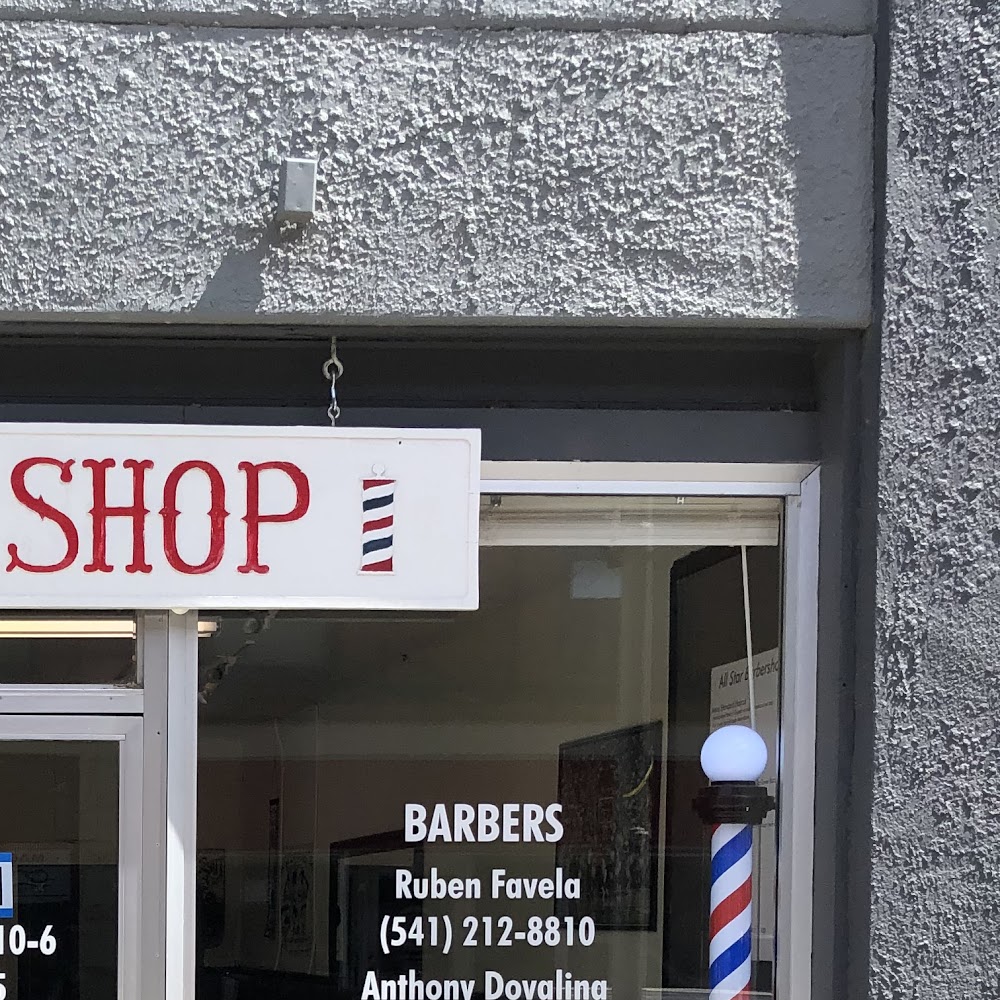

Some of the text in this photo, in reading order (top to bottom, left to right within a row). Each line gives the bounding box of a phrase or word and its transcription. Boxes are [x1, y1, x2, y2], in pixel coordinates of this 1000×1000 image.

[6, 457, 310, 575] SHOP
[404, 802, 564, 843] BARBERS
[395, 867, 581, 900] Ruben Favela
[380, 914, 596, 955] (541) 212-8810
[484, 968, 608, 1000] Dovalina
